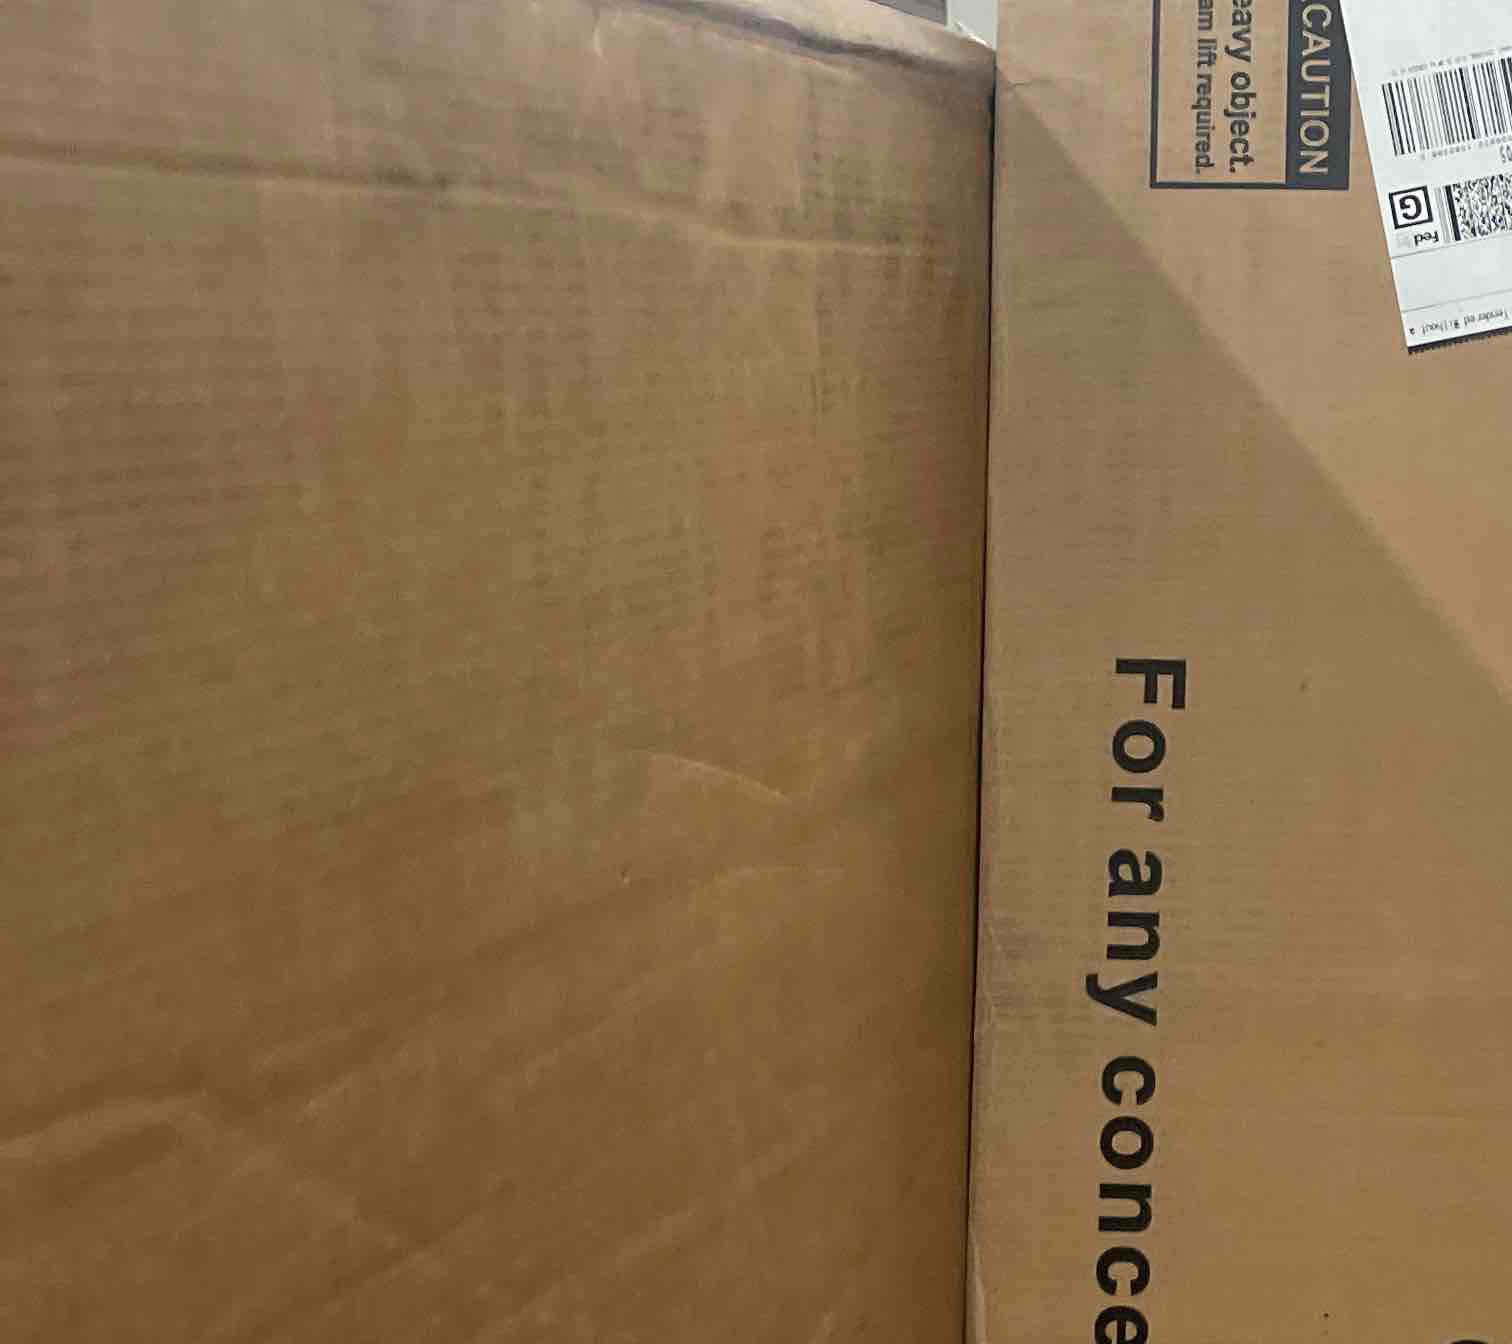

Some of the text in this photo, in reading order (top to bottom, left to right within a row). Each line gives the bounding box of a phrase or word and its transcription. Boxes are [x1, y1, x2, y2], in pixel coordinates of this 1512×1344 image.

[1197, 38, 1217, 67] lift
[1299, 3, 1333, 175] CAUTION
[1223, 71, 1257, 174] object.
[1398, 192, 1422, 221] G
[1112, 658, 1187, 822] For
[1086, 849, 1163, 1027] any
